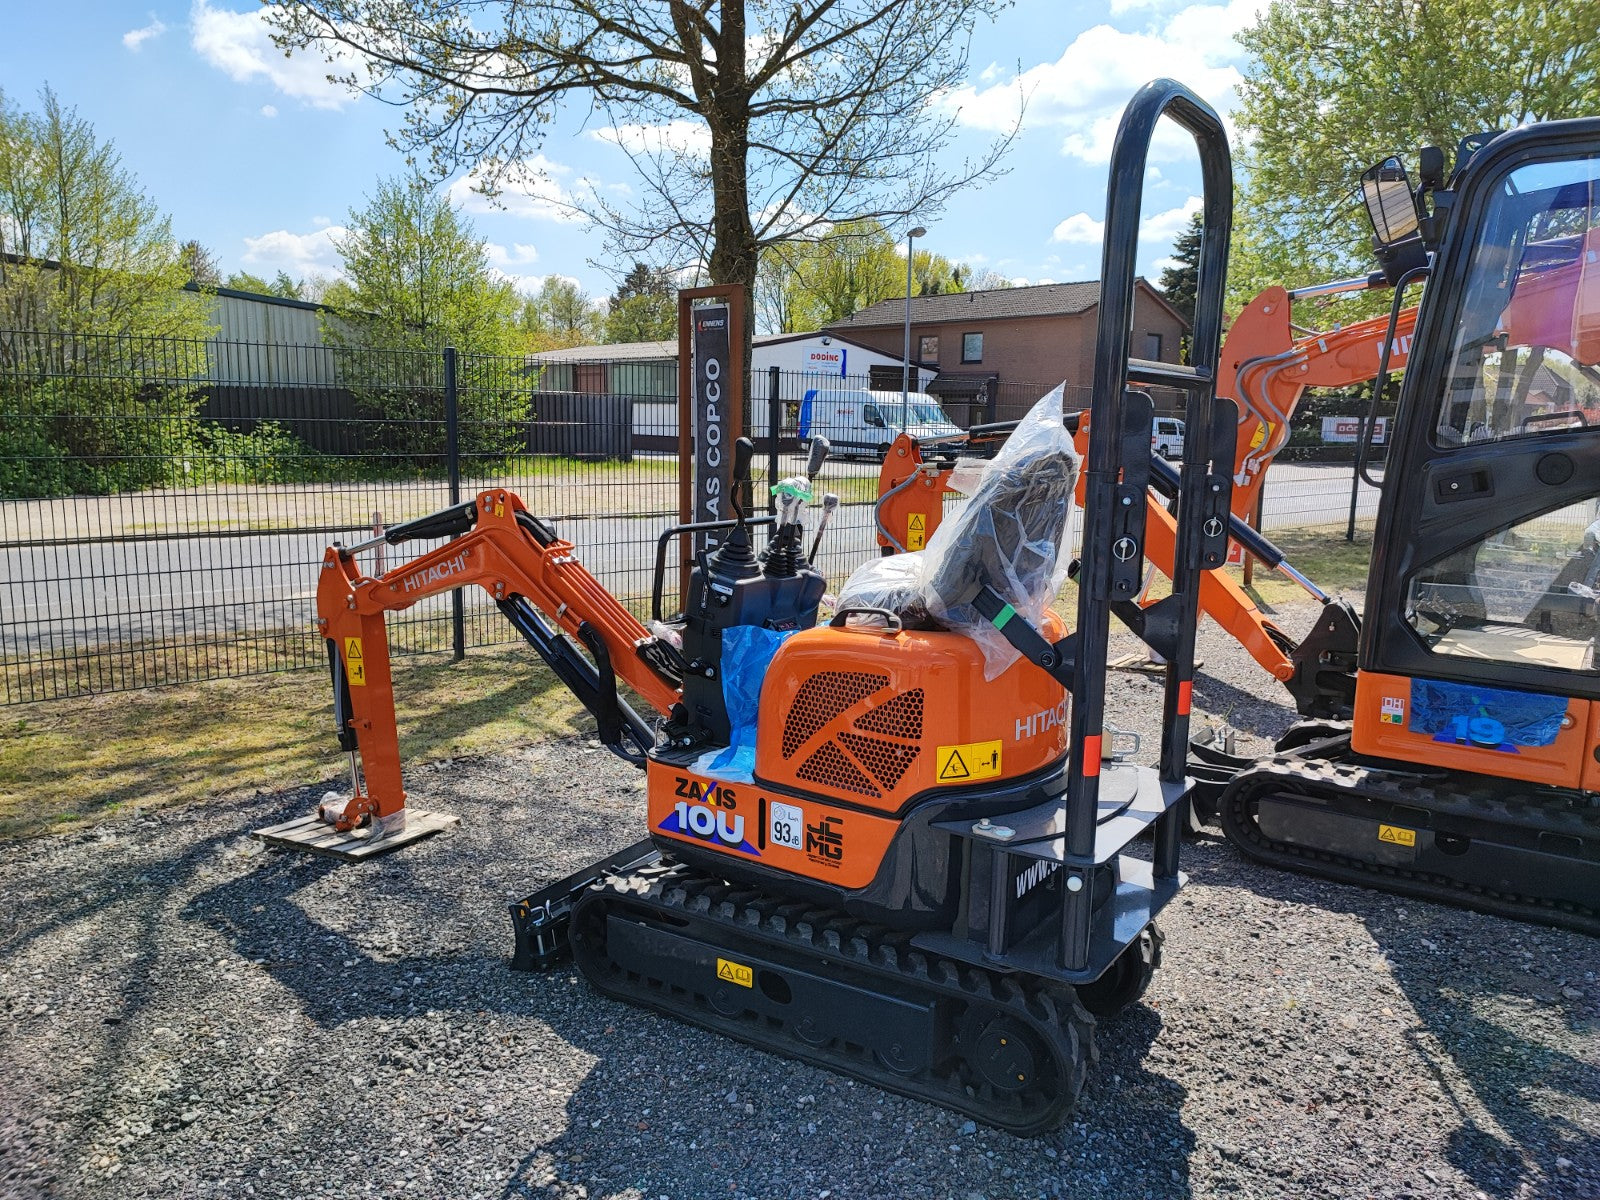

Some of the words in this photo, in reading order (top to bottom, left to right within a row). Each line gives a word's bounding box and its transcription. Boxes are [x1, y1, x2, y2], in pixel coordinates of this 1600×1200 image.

[705, 357, 721, 468] COPCO
[403, 555, 465, 592] HITACHI
[1015, 699, 1066, 741] HITAC
[1452, 715, 1505, 745] 19
[675, 777, 736, 810] ZAXIS
[675, 801, 745, 844] 10U
[774, 821, 791, 843] 93
